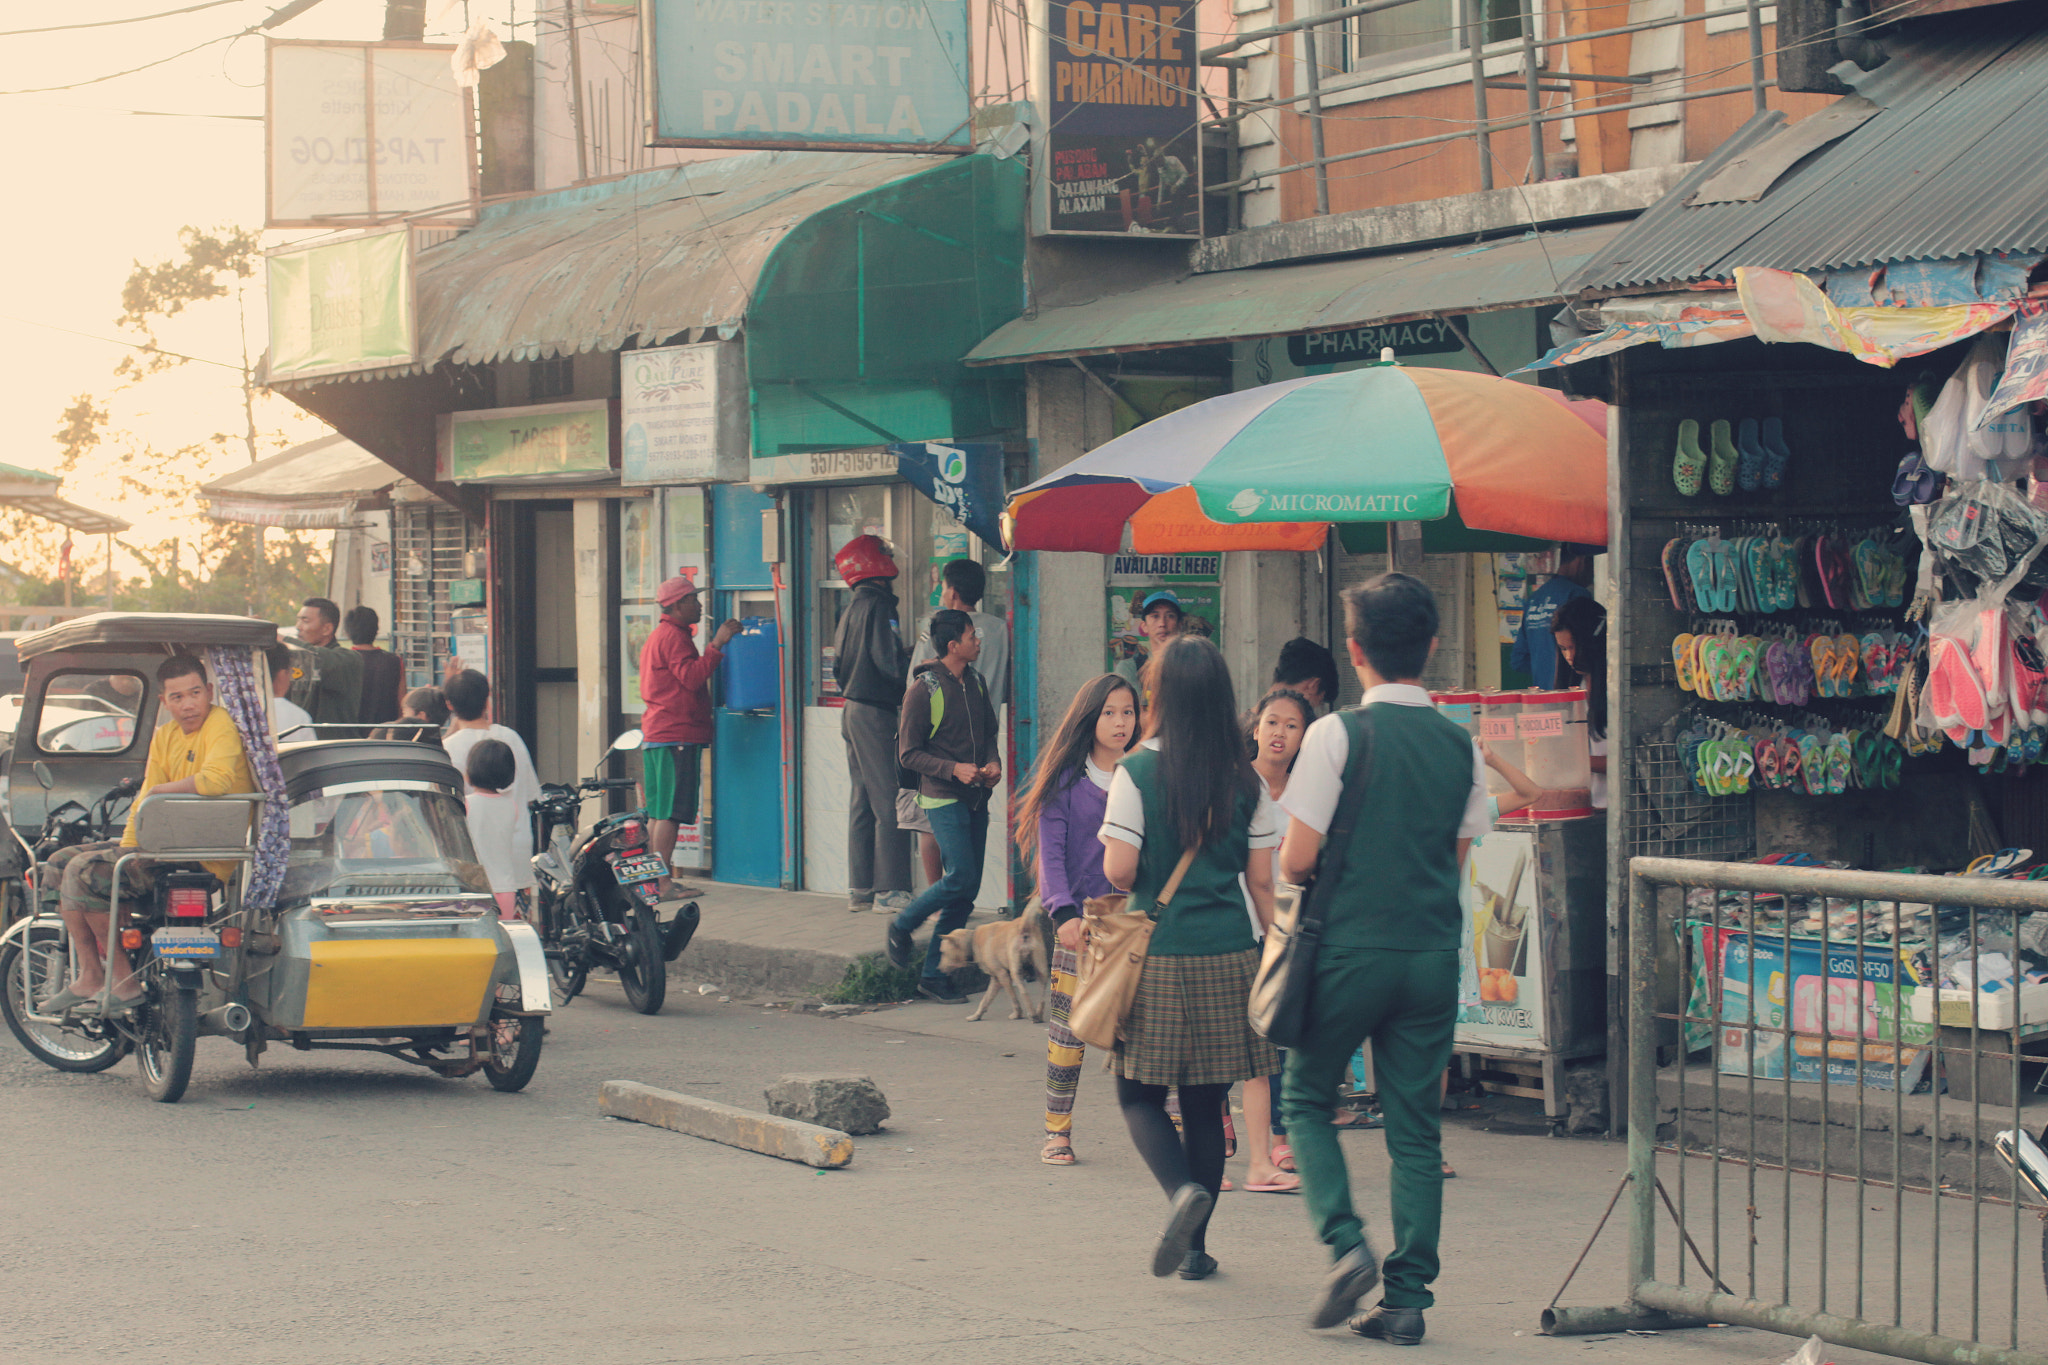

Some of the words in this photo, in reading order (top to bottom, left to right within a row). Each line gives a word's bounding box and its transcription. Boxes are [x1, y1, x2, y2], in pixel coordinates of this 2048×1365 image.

[695, 2, 794, 26] WATER
[805, 4, 926, 30] STATION
[1065, 1, 1182, 60] CARE
[714, 41, 913, 86] SMART
[1056, 61, 1191, 107] PHARMACY
[702, 90, 925, 136] PADALA
[1059, 196, 1105, 214] ALAXAN
[1305, 321, 1450, 355] PHARMACY
[509, 422, 592, 450] TAPSIOG
[1269, 494, 1418, 513] MICROMATIC
[1114, 556, 1182, 574] AVAILABLE
[1184, 556, 1217, 574] HERE
[621, 861, 660, 876] PLATE
[159, 946, 215, 955] Motortrade
[1797, 983, 1870, 1032] 1GB
[1886, 1021, 1926, 1038] TXTS
